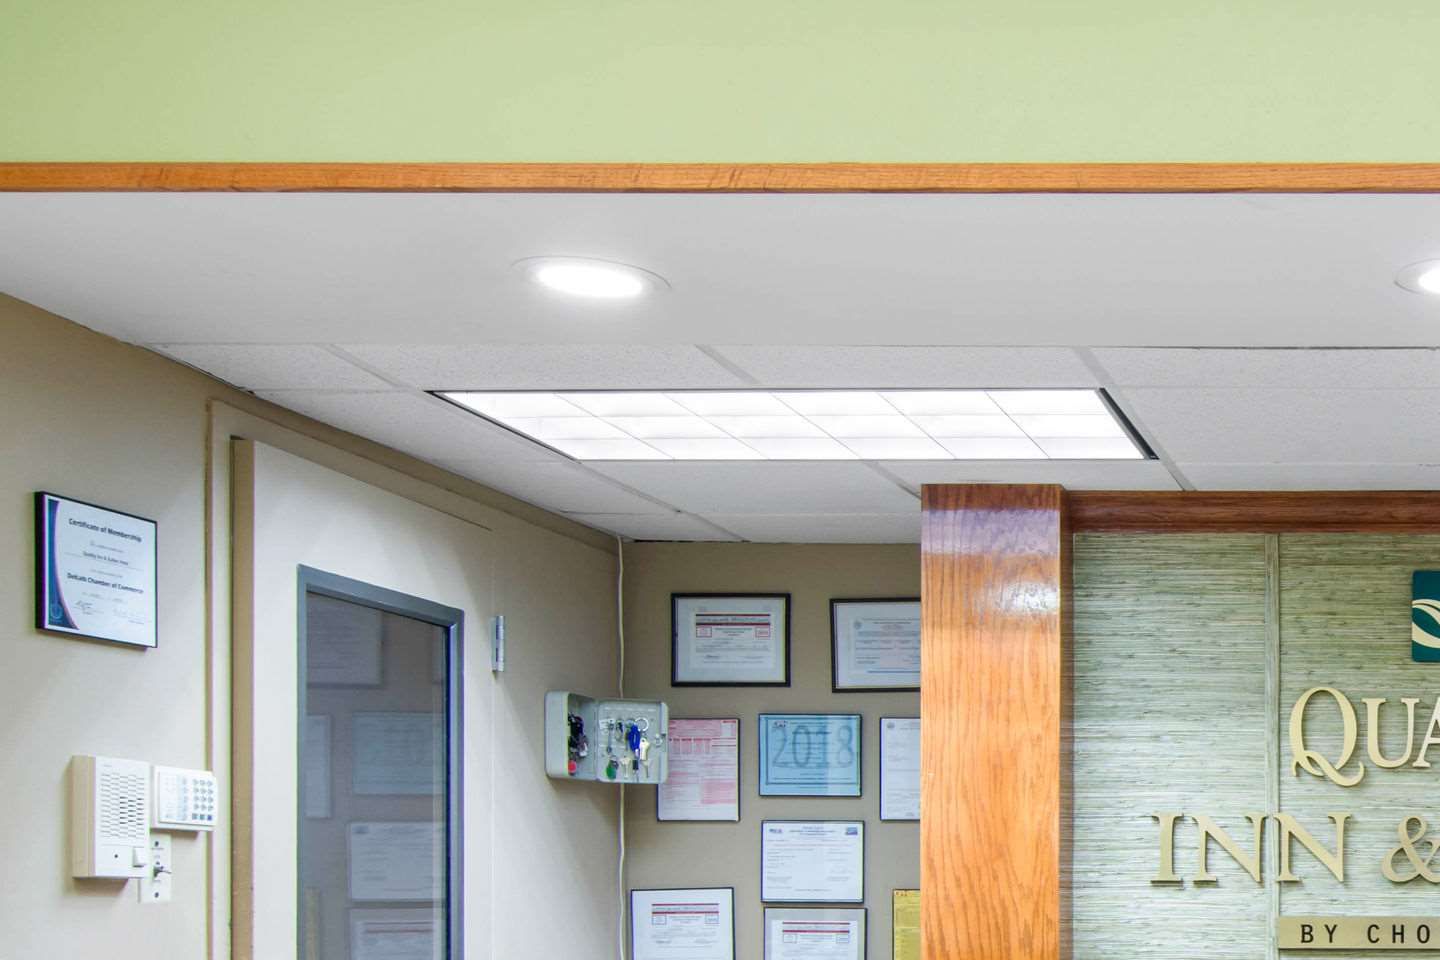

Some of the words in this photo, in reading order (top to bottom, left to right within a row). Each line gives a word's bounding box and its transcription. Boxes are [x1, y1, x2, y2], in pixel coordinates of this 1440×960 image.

[771, 725, 855, 769] 2018
[1150, 811, 1353, 886] INN
[1300, 924, 1338, 944] BY
